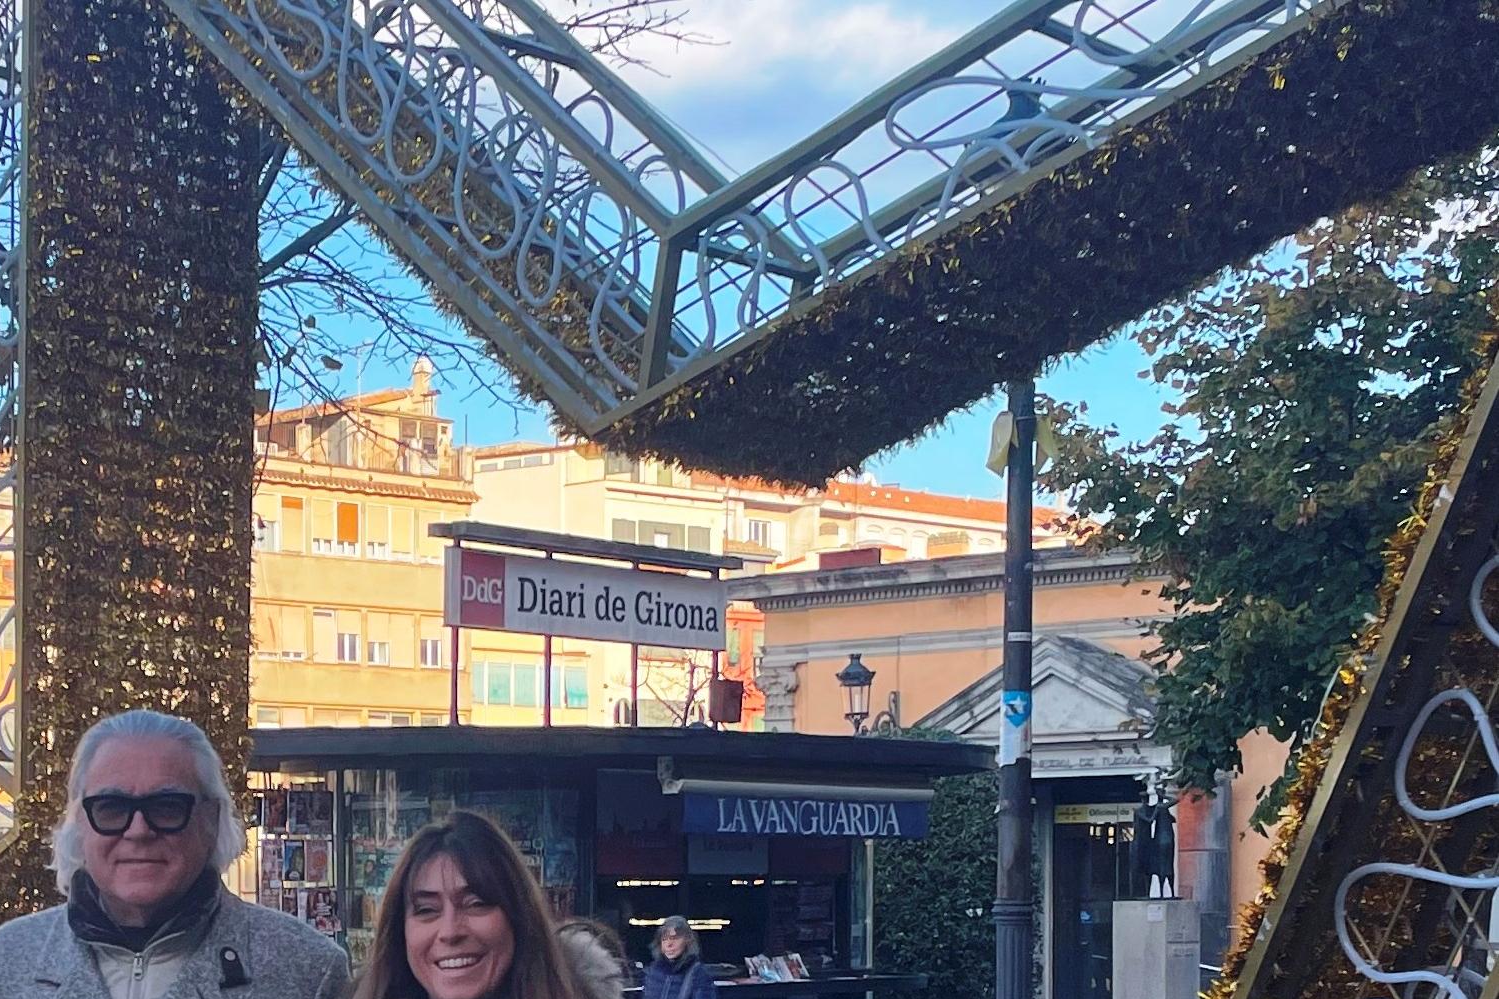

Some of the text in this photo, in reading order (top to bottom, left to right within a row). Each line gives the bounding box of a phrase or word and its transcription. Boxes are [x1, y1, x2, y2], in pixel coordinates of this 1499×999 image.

[462, 575, 503, 605] DdG
[517, 576, 720, 633] Diari de Girona
[717, 798, 901, 836] LA VANGUARDIA
